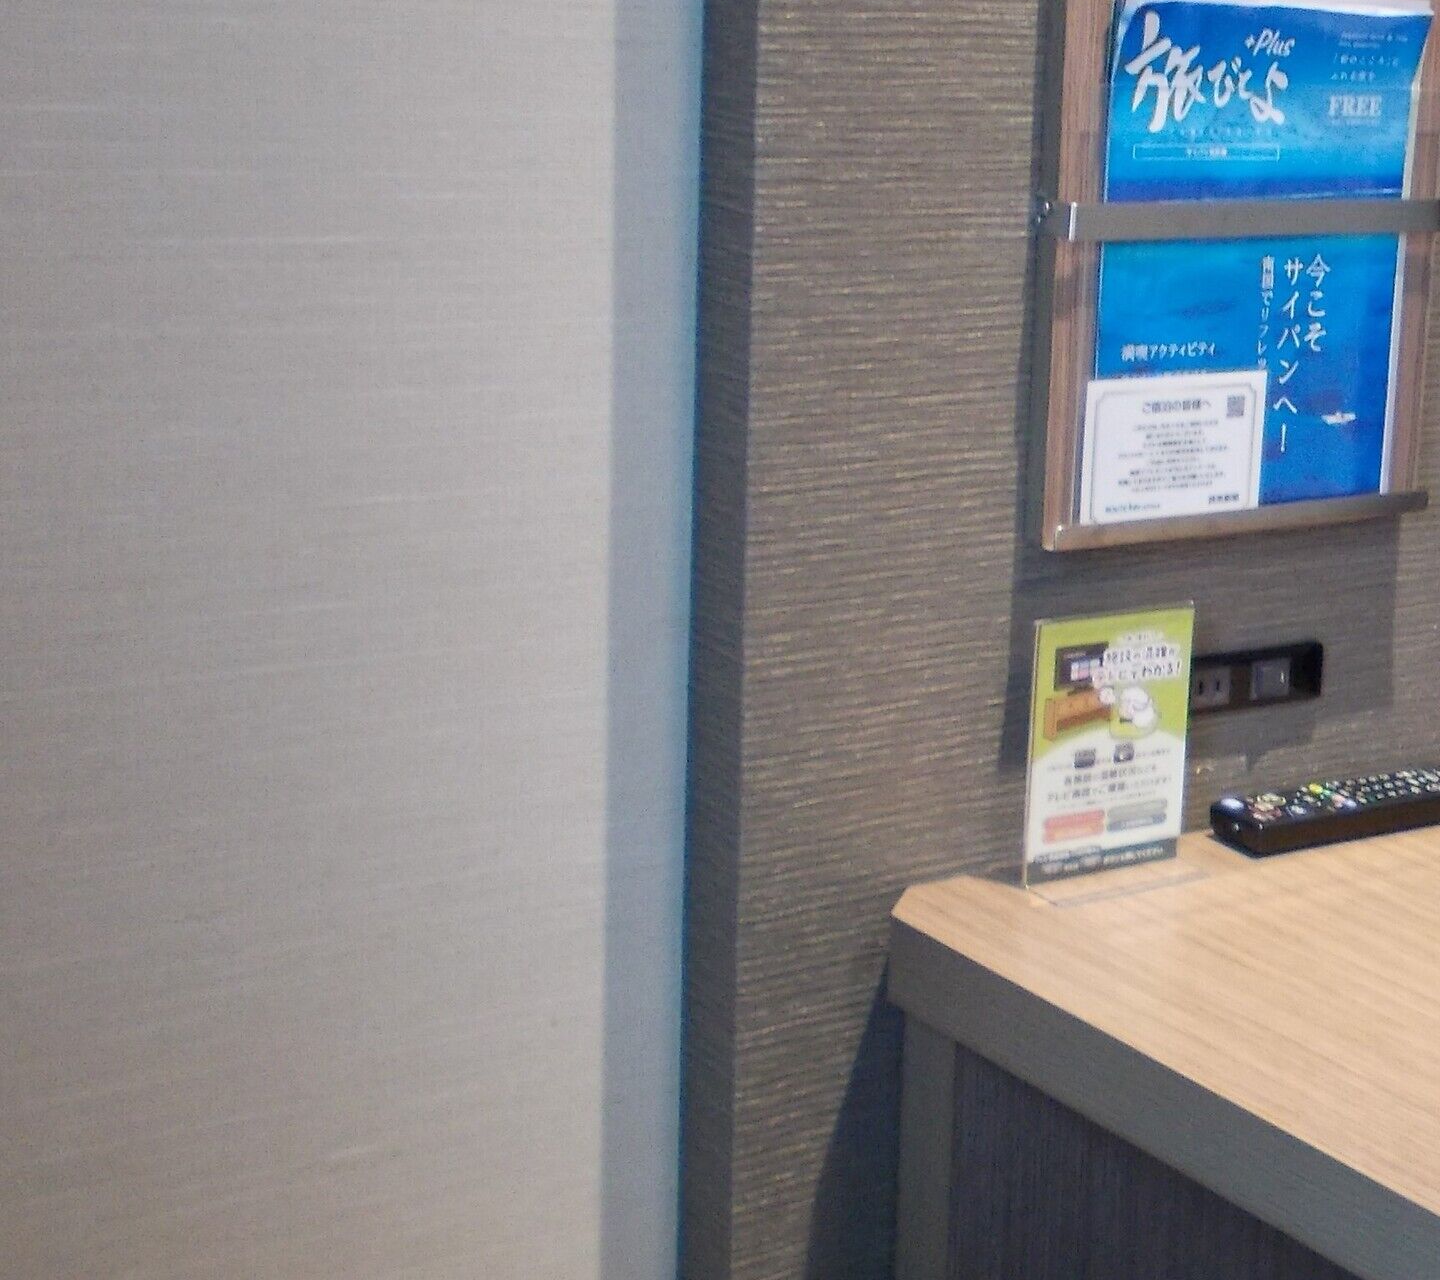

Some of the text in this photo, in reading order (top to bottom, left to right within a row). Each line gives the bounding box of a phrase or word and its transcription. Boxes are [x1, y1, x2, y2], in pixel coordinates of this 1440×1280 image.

[1329, 95, 1382, 116] FREE
[1304, 253, 1332, 352] 今こそ
